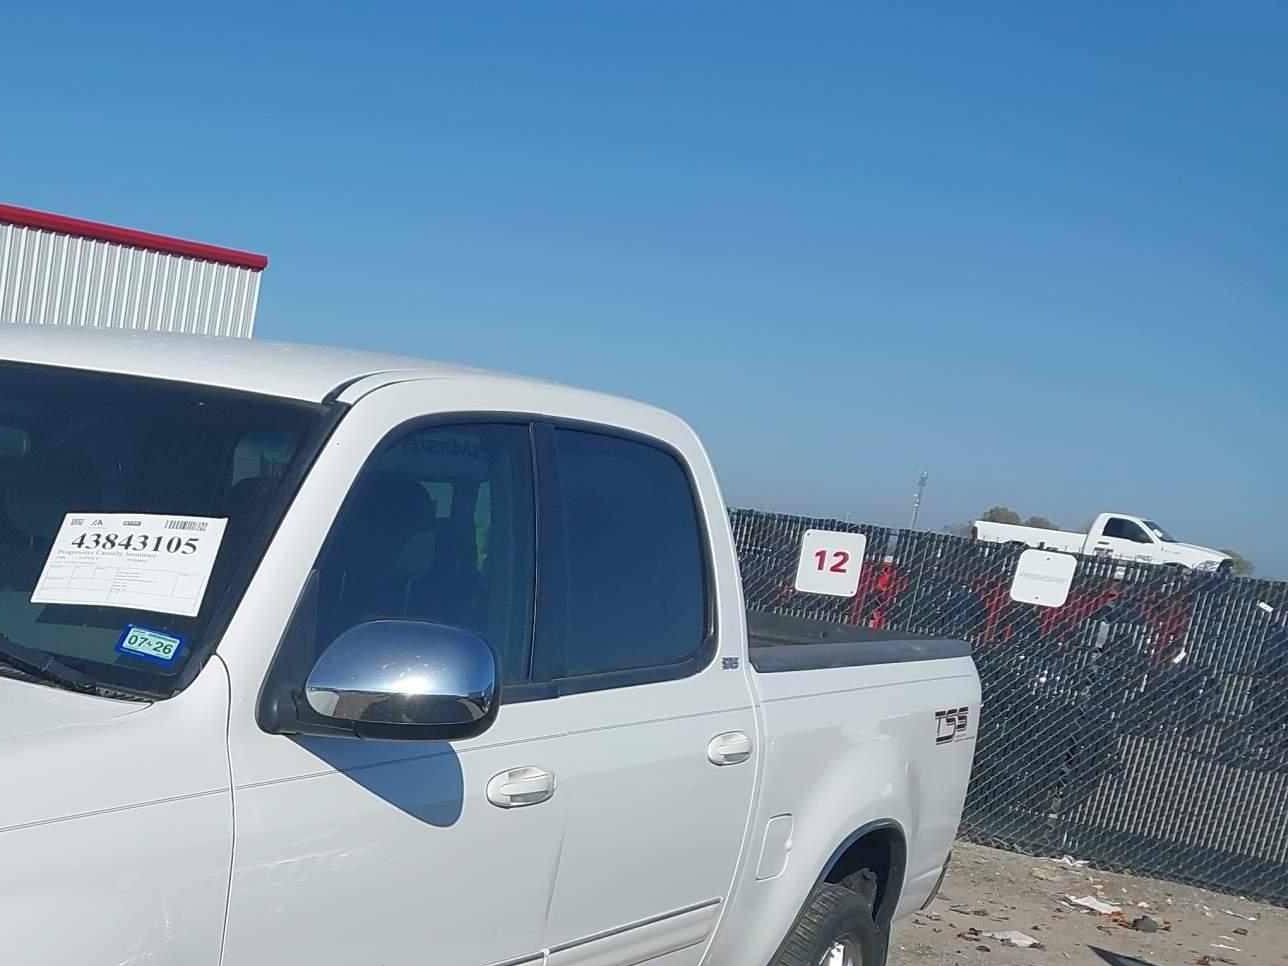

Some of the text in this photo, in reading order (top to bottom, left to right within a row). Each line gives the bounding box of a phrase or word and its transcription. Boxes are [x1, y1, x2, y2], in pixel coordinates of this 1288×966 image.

[71, 532, 199, 555] 43843105
[814, 549, 850, 574] 12
[128, 634, 148, 647] 07
[152, 641, 173, 655] 26
